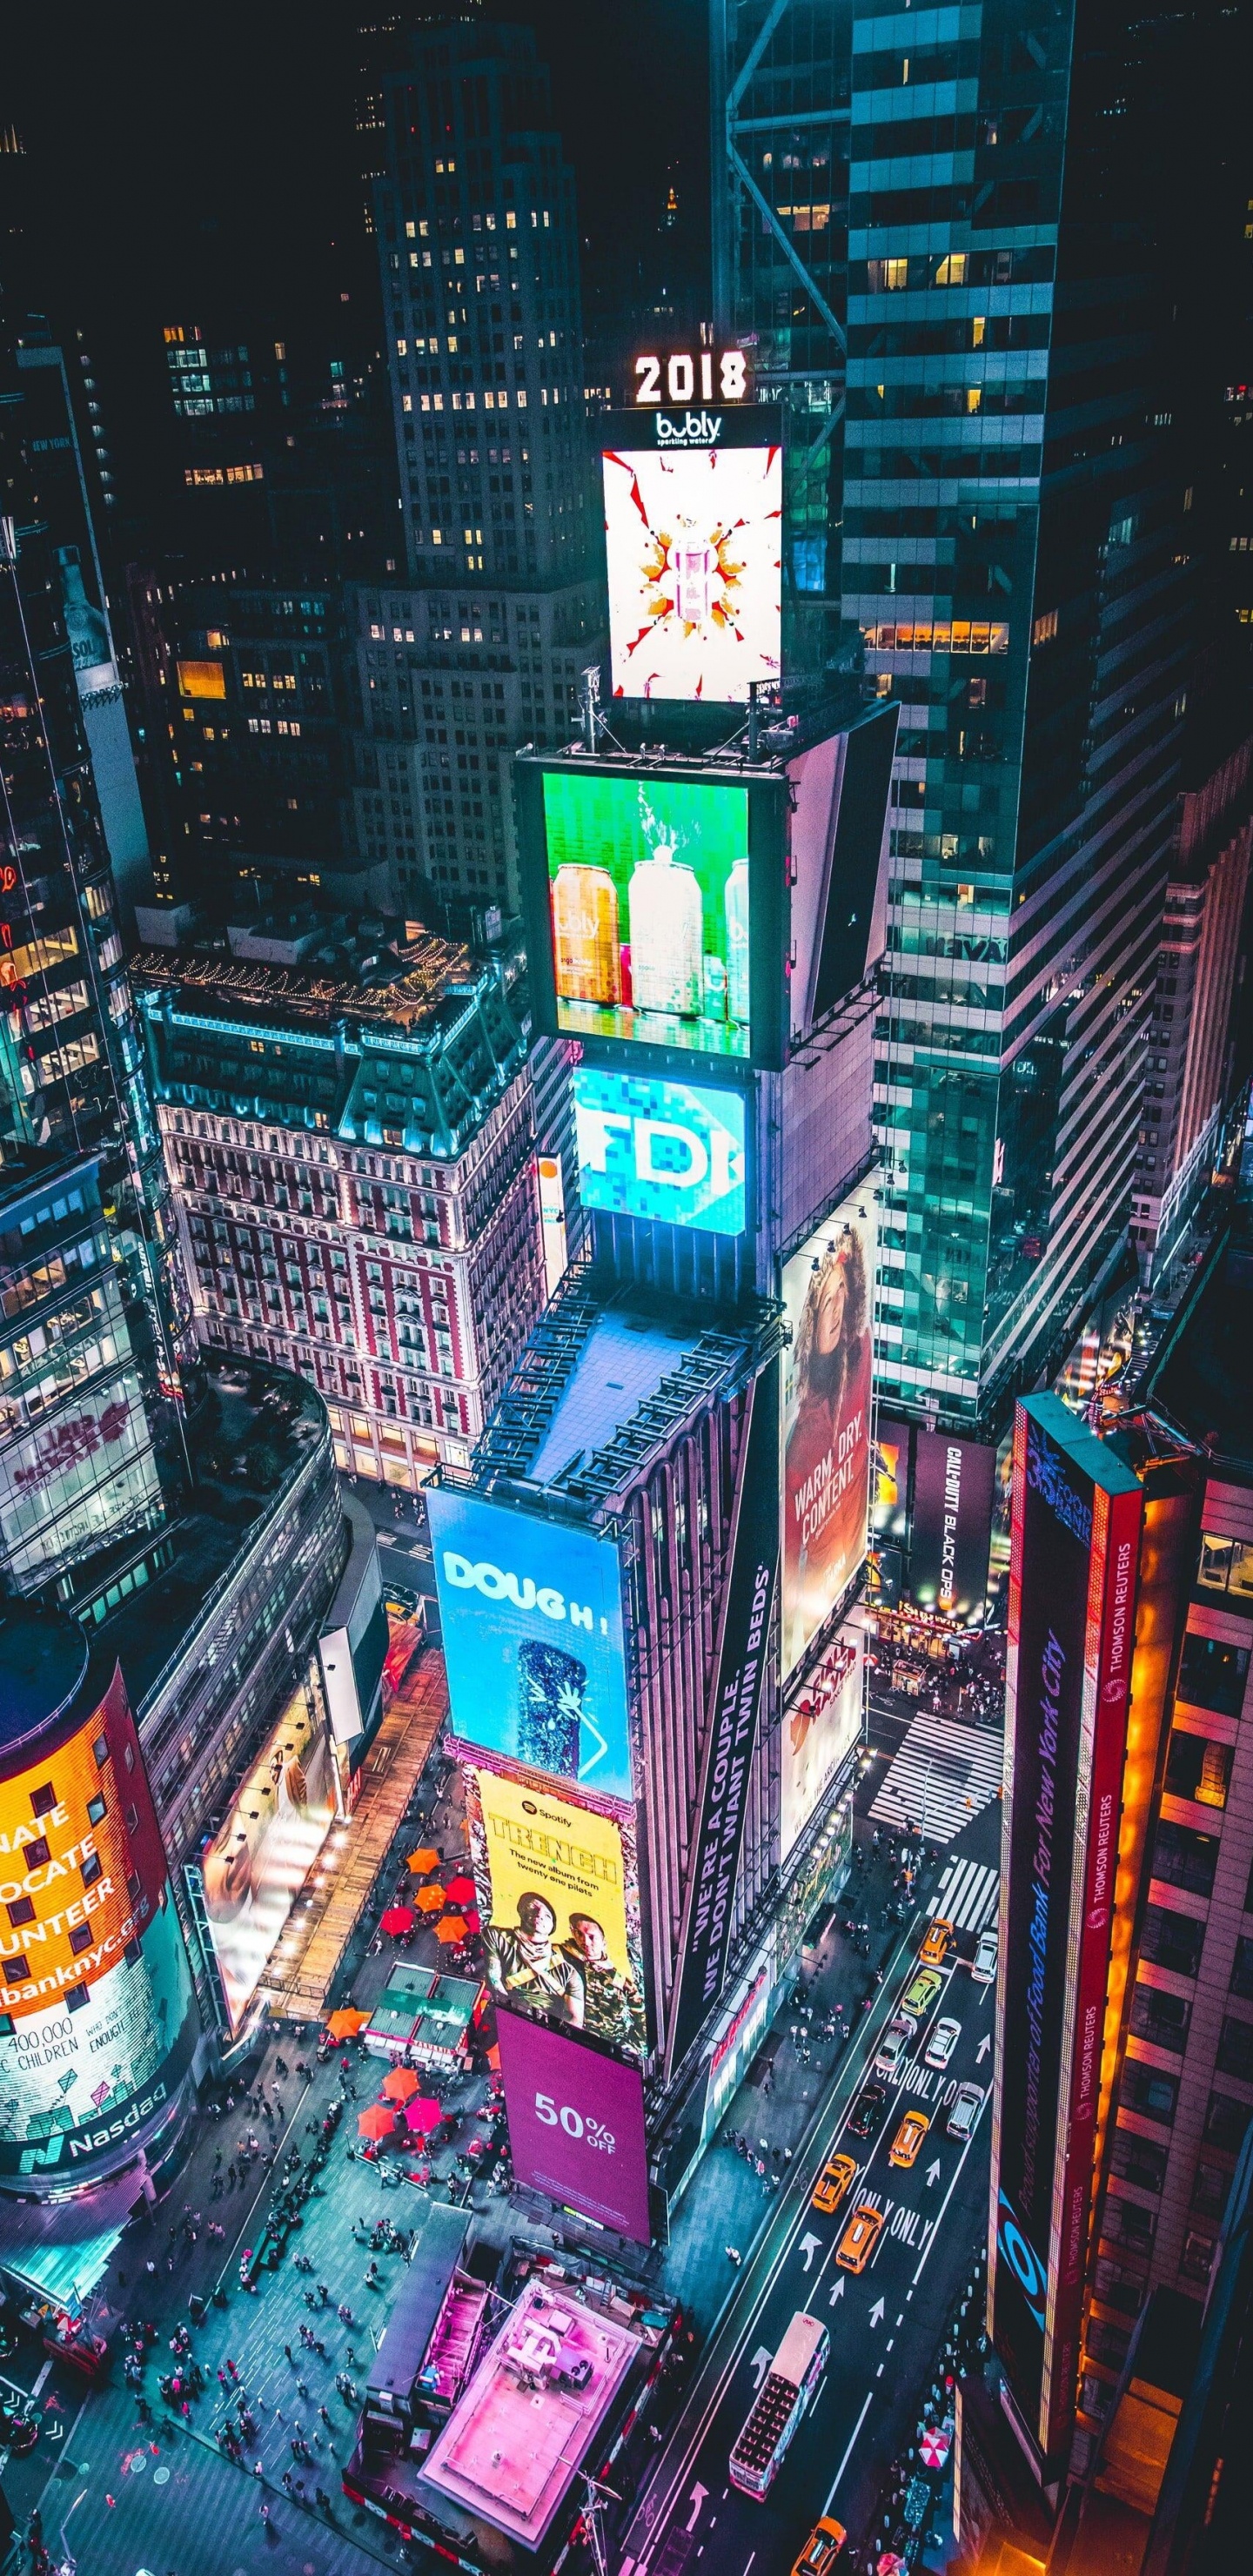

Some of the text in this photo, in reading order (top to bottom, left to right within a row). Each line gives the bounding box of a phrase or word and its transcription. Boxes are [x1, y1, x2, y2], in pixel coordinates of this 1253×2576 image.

[635, 351, 747, 402] 2018
[48, 436, 70, 450] YORK
[795, 1448, 834, 1522] WARM.
[838, 1410, 861, 1465] DRY.
[802, 1452, 854, 1546] CONTENT.
[941, 1446, 962, 1599] CALL DUTY BLACK OPS
[443, 1550, 608, 1636] DOUGH!
[1110, 1542, 1131, 1673] THOMSON REUTERS
[1042, 1627, 1067, 1697] City
[712, 1669, 740, 1802] COUPLE.
[735, 1660, 757, 1747] TWIN
[1039, 1696, 1059, 1768] York
[539, 1808, 572, 1828] Spotify
[708, 1807, 722, 1829] A
[723, 1756, 745, 1847] WANT
[1034, 1764, 1055, 1840] New
[488, 1812, 617, 1885] TRENCH
[509, 1848, 600, 1891] The new album from
[517, 1861, 548, 1881] twenty
[1032, 1832, 1052, 1888] For
[1094, 1794, 1112, 1903] THOMSON REUTERS
[710, 1853, 733, 1946] DON'T
[1029, 1882, 1049, 1956] Bank
[702, 1948, 720, 2002] WE
[1027, 1942, 1045, 2020] Food
[8, 2017, 73, 2054] 400,000
[18, 2036, 79, 2070] CHILDREN
[90, 2022, 125, 2054] ENOUGH
[1027, 2005, 1042, 2047] of
[1080, 2005, 1096, 2099] THOMSON REUTERS
[70, 2082, 167, 2157] Nasdaq
[534, 2090, 616, 2145] 50%
[906, 2065, 946, 2103] ONLY
[586, 2134, 616, 2155] OFF
[890, 2206, 934, 2251] ONLY
[1069, 2185, 1083, 2269] THOMSON REUTERS
